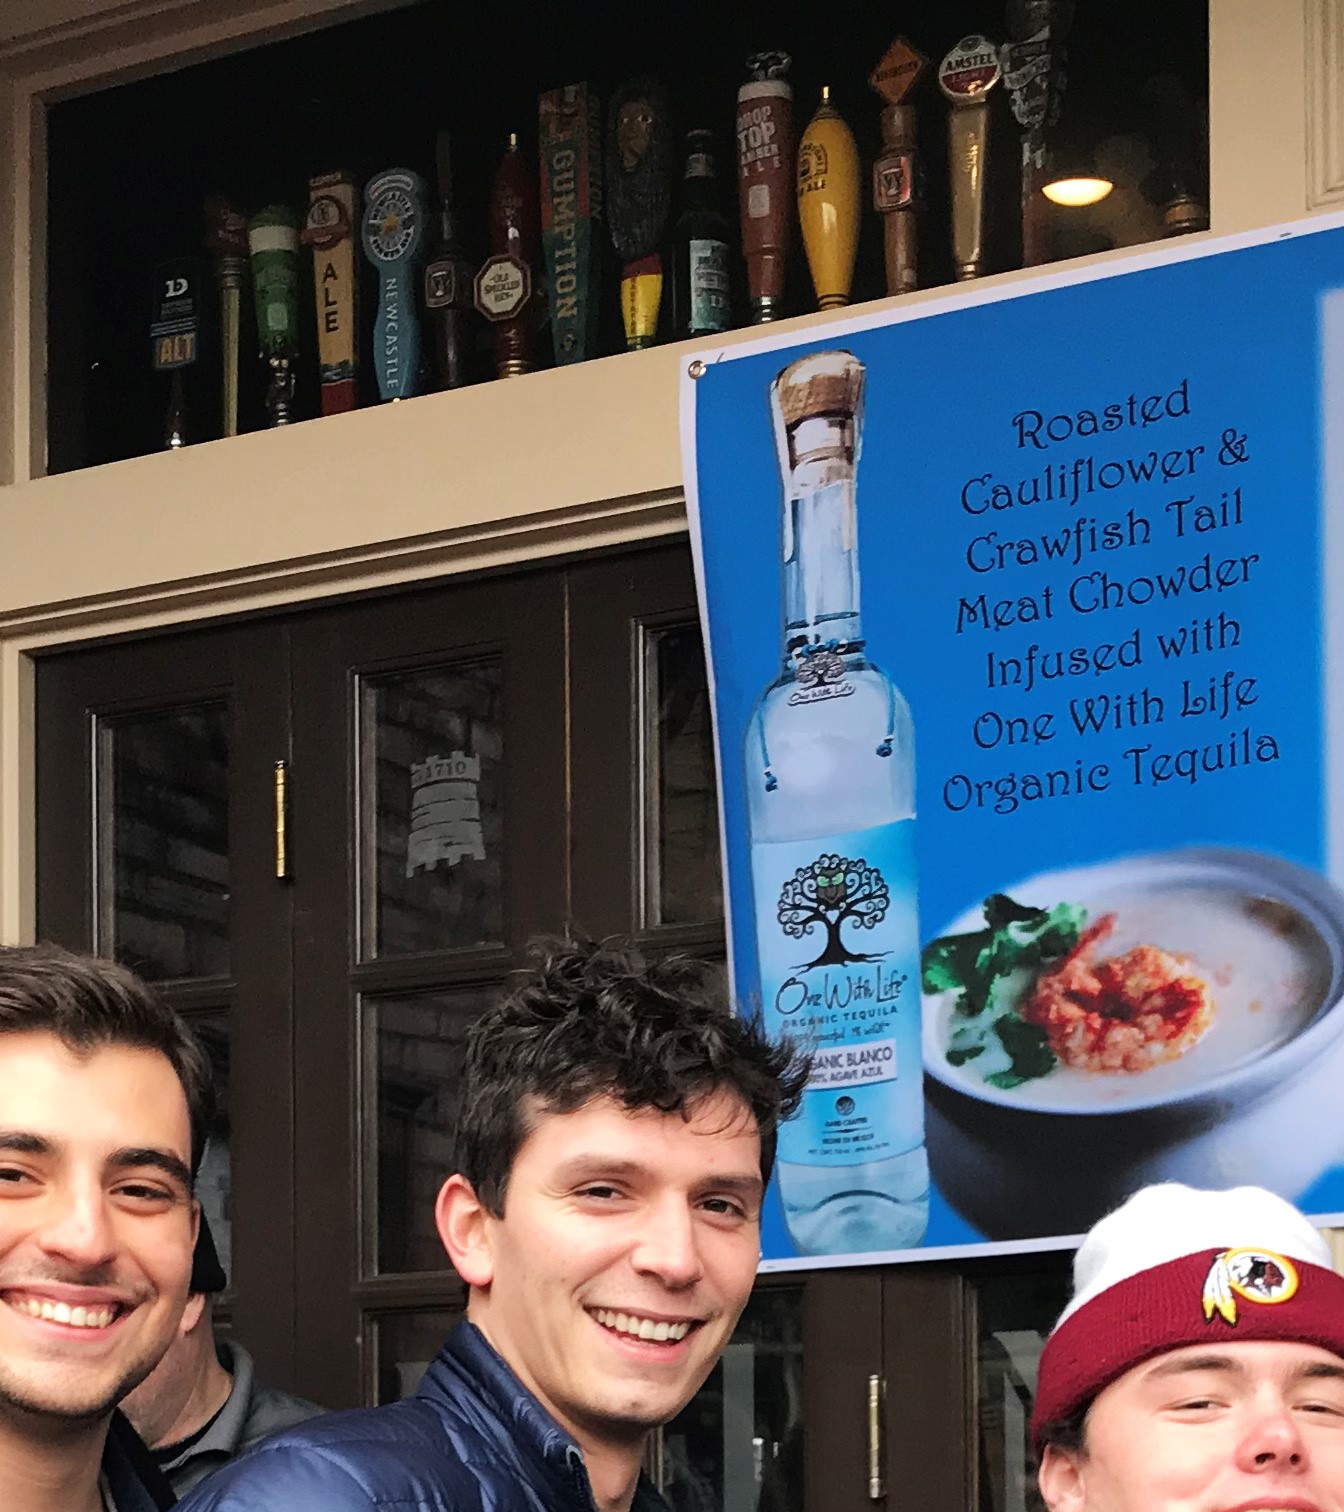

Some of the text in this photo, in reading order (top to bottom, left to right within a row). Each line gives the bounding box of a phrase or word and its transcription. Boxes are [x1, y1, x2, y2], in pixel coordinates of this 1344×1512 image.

[945, 53, 994, 72] AMSTEL
[738, 121, 776, 153] TOP
[552, 149, 578, 320] GUMPTION
[321, 262, 338, 333] ALE
[385, 278, 399, 390] NEWCASTLE
[159, 334, 194, 363] ALT
[1012, 378, 1191, 450] Roasted
[961, 428, 1250, 515] Cauliflower &
[966, 488, 1244, 574] Crawfish Tail
[956, 552, 1260, 634] Meat Chowder
[986, 612, 1241, 692] Infused with
[973, 671, 1260, 749] One With Life
[943, 728, 1280, 815] Organic Tequila
[775, 976, 822, 1014] One
[825, 972, 875, 1010] With
[843, 1005, 898, 1020] TEQUILA
[846, 1046, 893, 1067] BLANCO
